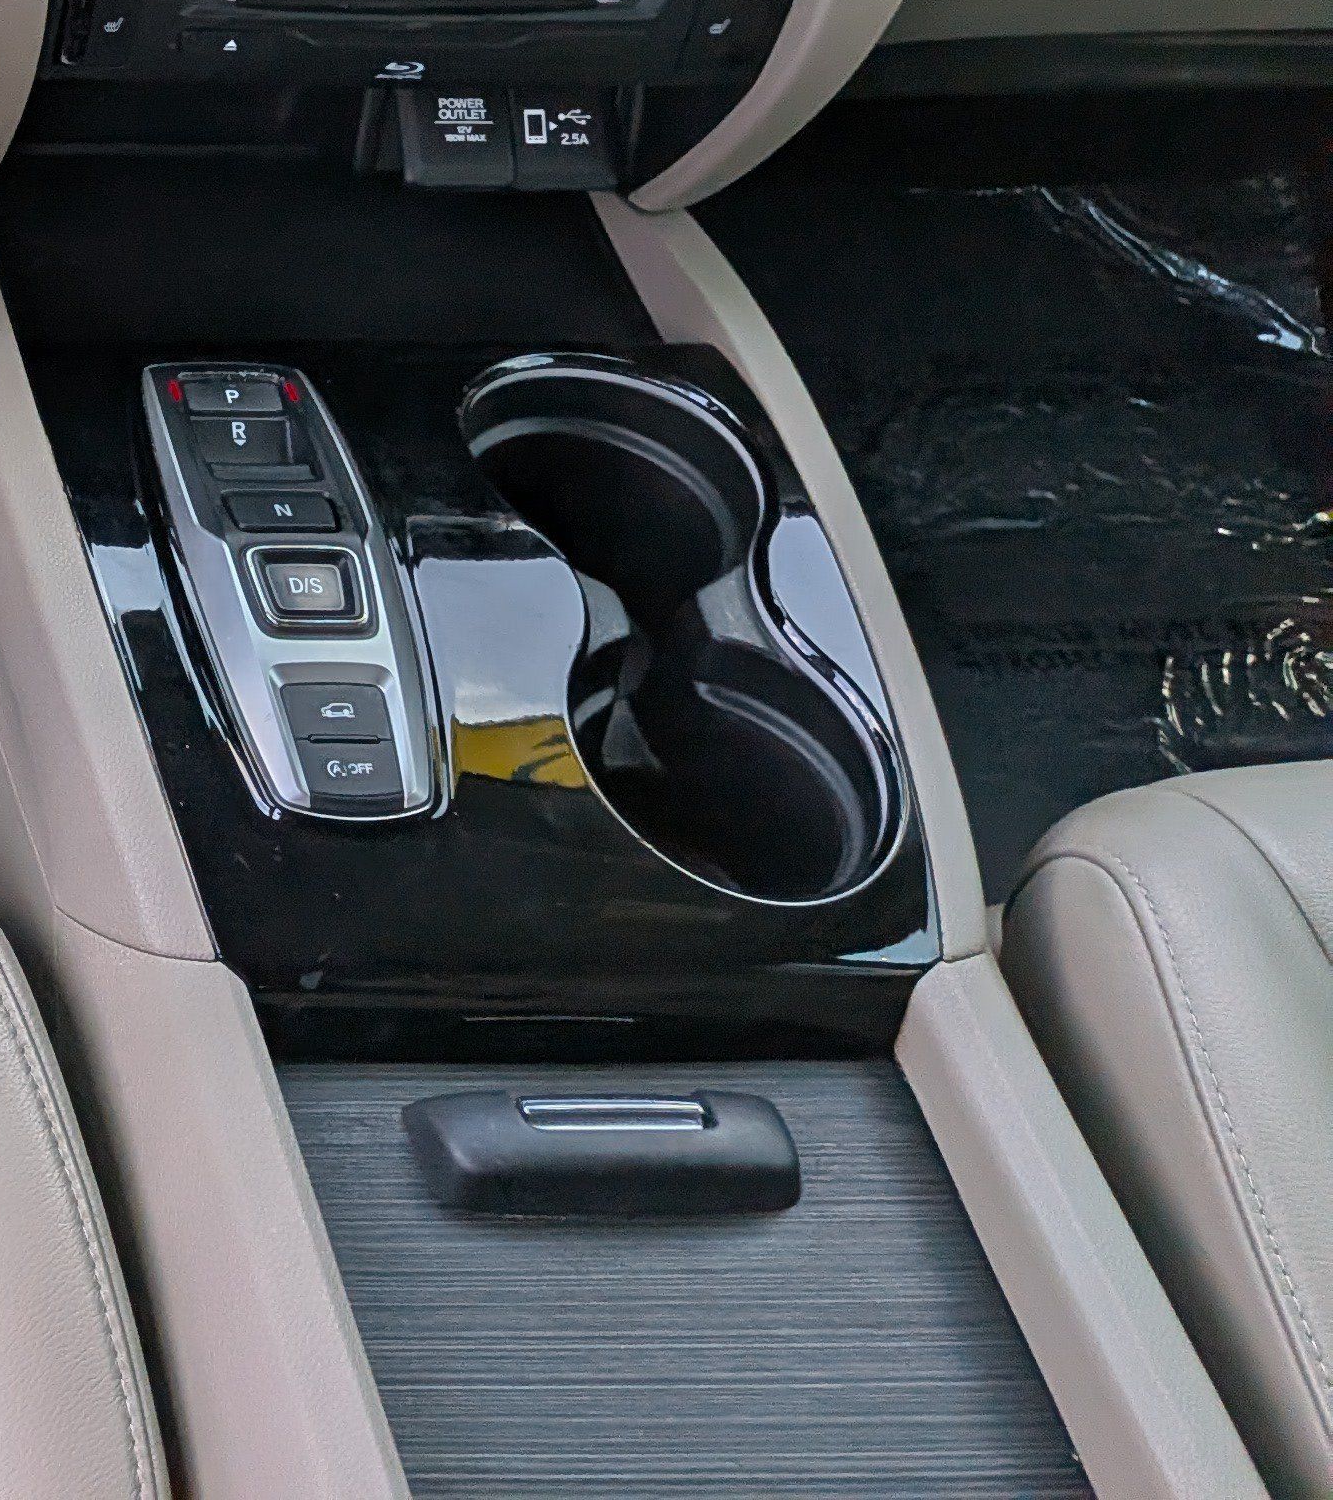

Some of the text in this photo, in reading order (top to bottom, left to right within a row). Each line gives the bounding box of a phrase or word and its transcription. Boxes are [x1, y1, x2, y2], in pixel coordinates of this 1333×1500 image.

[438, 98, 484, 109] POWER
[438, 109, 486, 120] OUTLET
[560, 132, 590, 145] 2.5A
[225, 389, 240, 404] P
[231, 421, 246, 439] R
[274, 503, 293, 517] N
